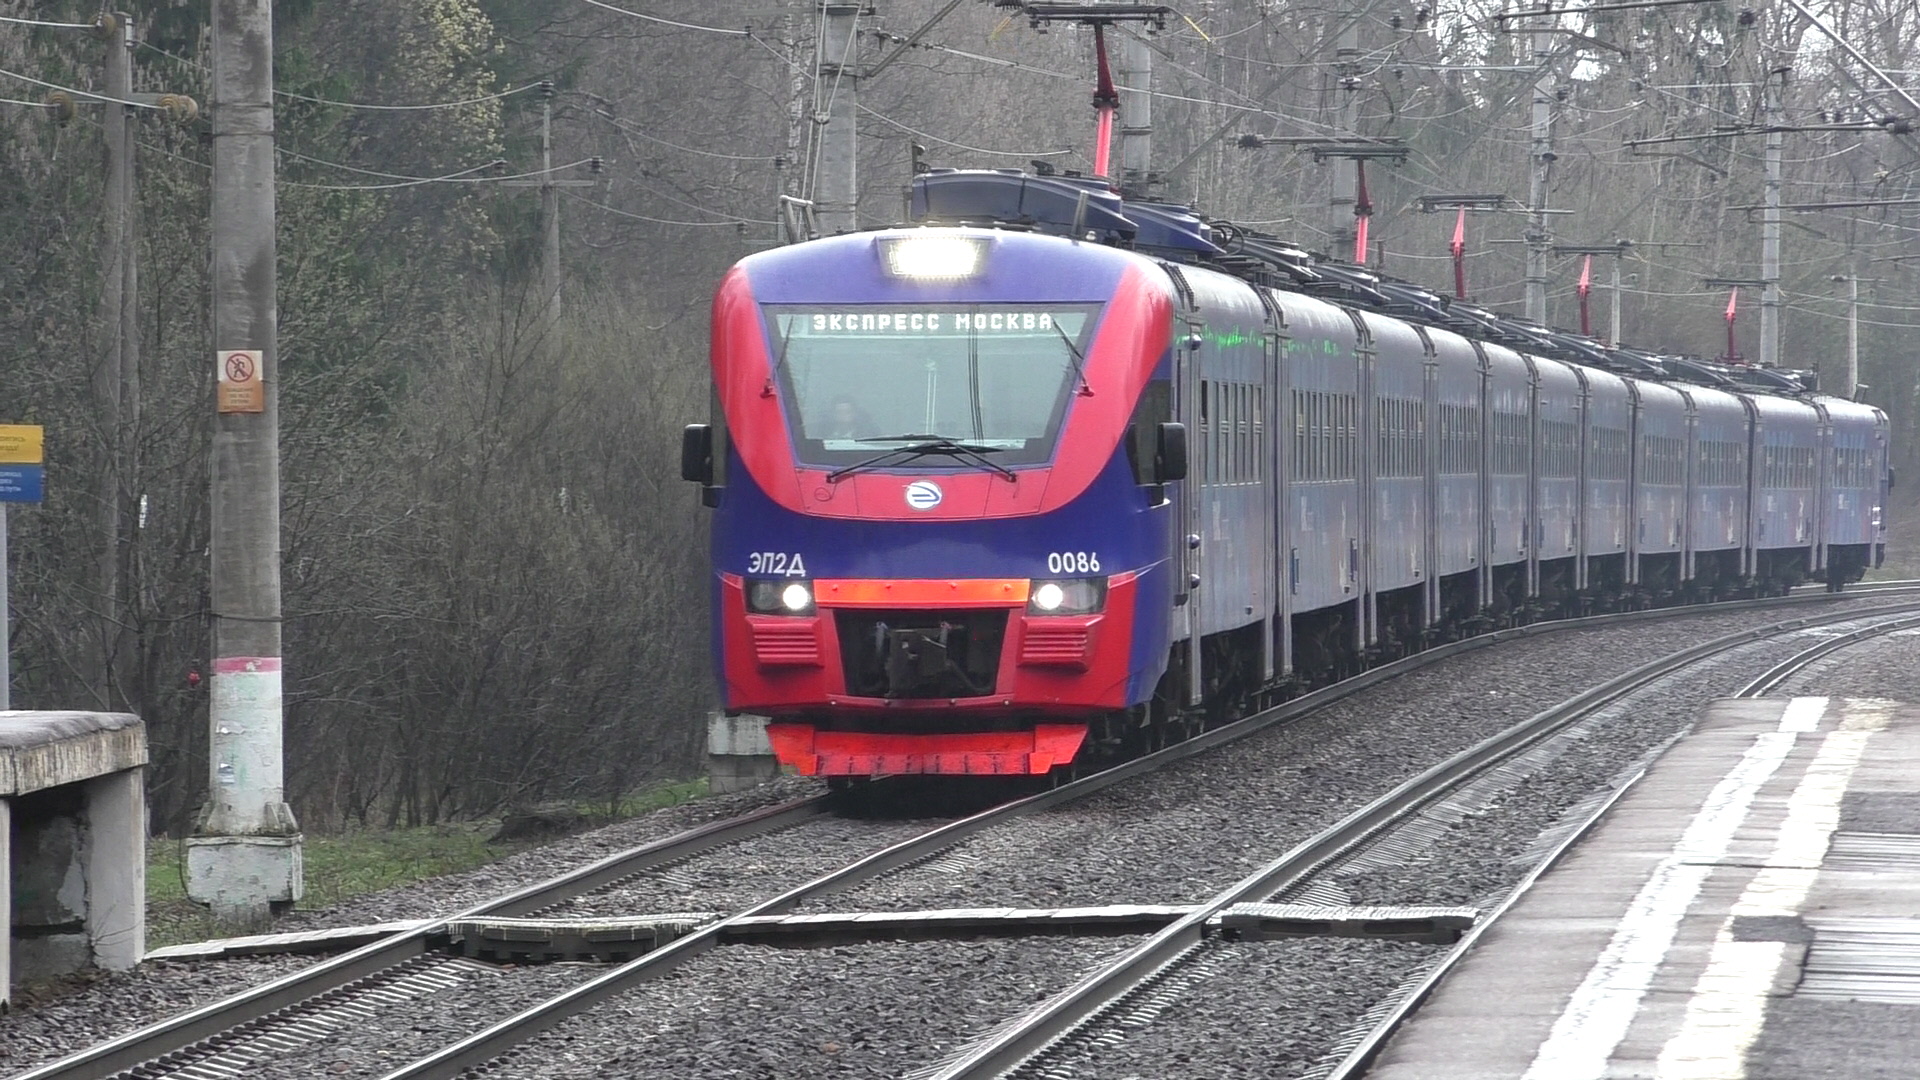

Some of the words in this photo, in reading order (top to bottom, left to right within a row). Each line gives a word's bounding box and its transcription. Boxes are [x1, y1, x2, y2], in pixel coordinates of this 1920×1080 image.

[813, 313, 940, 331] ЭКСПРЕСС
[955, 313, 1053, 331] МОСКВА
[747, 552, 806, 577] ЭП2Д
[1048, 551, 1101, 574] 0086
